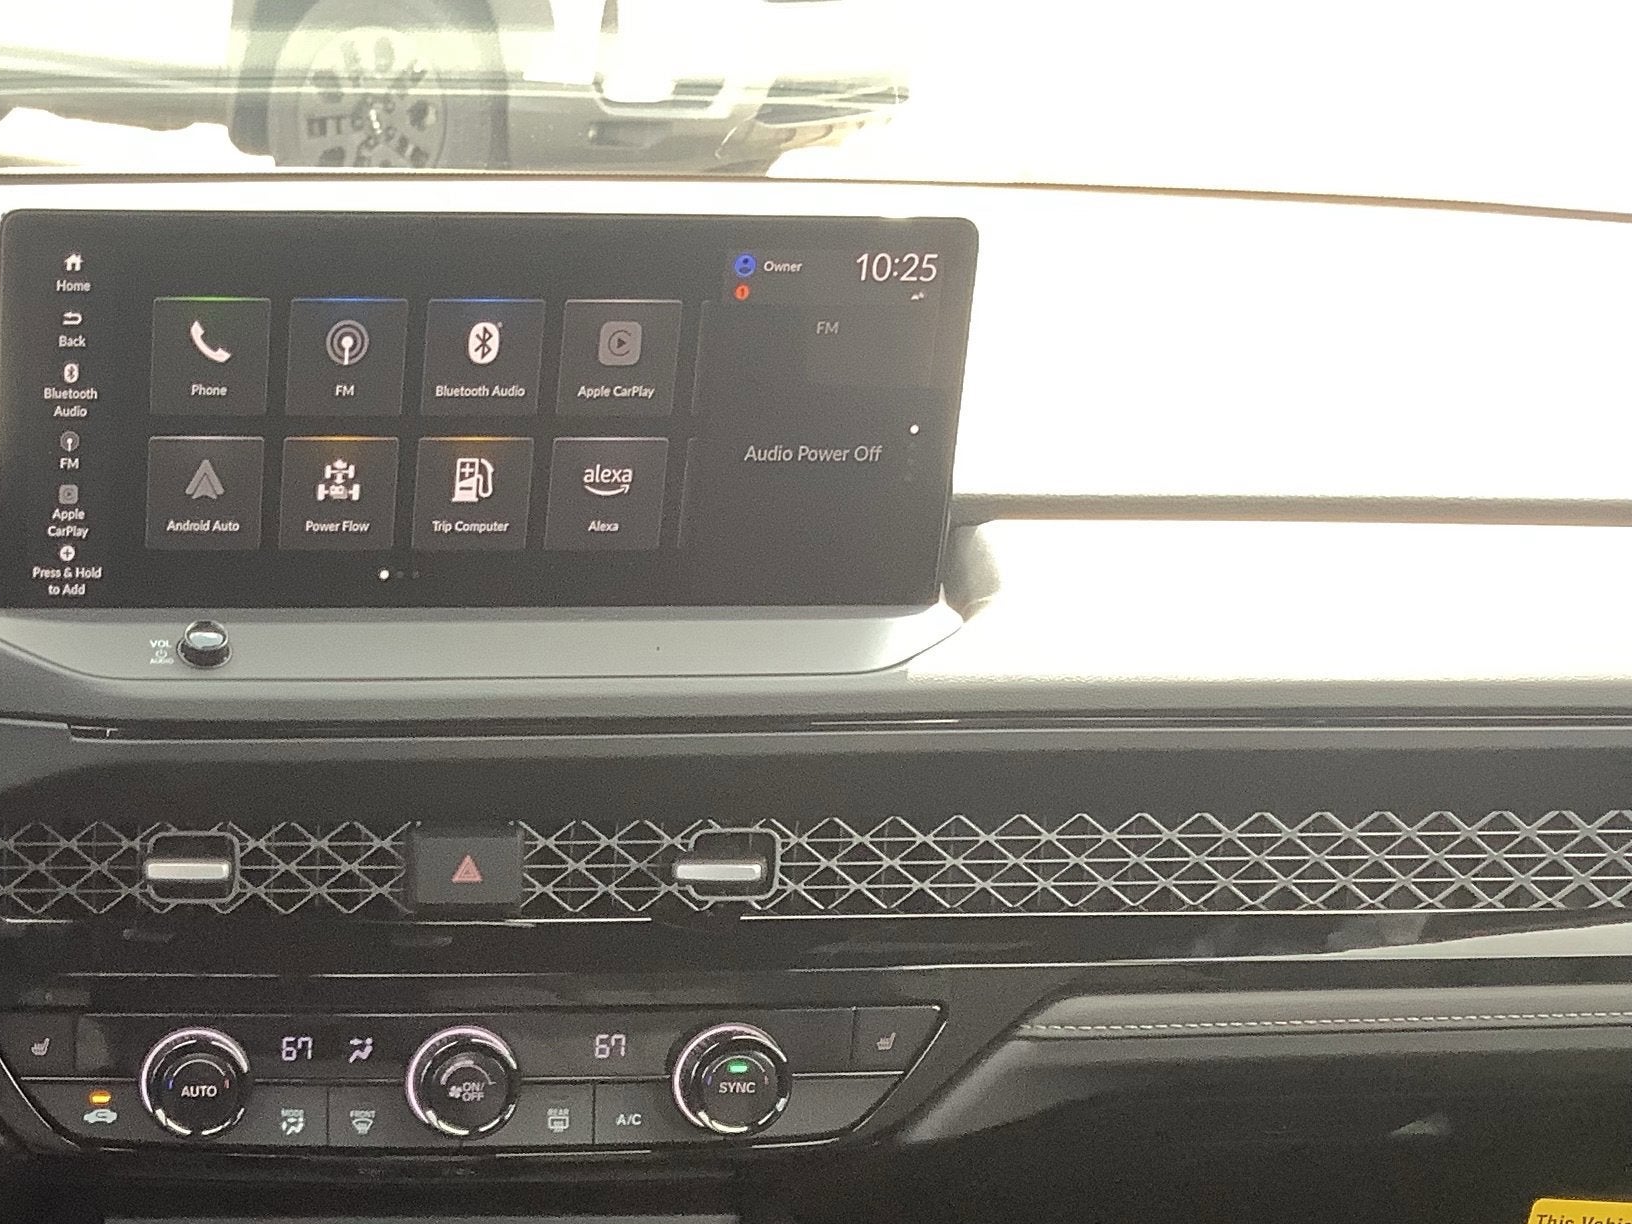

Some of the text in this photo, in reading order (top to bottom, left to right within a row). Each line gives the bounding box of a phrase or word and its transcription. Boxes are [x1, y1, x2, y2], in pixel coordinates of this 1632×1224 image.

[764, 261, 802, 272] Owner
[856, 253, 938, 282] 10:25
[56, 279, 91, 291] Home
[816, 321, 839, 334] FM
[59, 336, 86, 347] Back
[44, 388, 98, 400] Bluetooth
[191, 384, 227, 396] Phone
[335, 385, 355, 396] FM
[436, 385, 526, 397] Bluetooth Audio
[577, 385, 655, 399] Apple CarPlay
[54, 405, 87, 417] Audio
[744, 445, 883, 461] Audio Power Off
[60, 458, 79, 469] FM
[583, 464, 633, 483] alexa
[52, 508, 85, 522] Apple
[48, 525, 89, 539] CarPlay
[167, 520, 240, 532] Android Auto
[305, 521, 370, 532] Power Flow
[432, 521, 509, 535] Trip Computer
[588, 521, 619, 532] Alexa
[32, 567, 102, 579] Press & Hold
[48, 584, 85, 595] to Add
[149, 639, 172, 648] VOL
[281, 1037, 312, 1061] 67
[594, 1034, 625, 1059] 67
[181, 1084, 218, 1098] AUTO
[718, 1082, 755, 1094] SYNC
[462, 1092, 484, 1101] OFF
[616, 1113, 642, 1126] A/C
